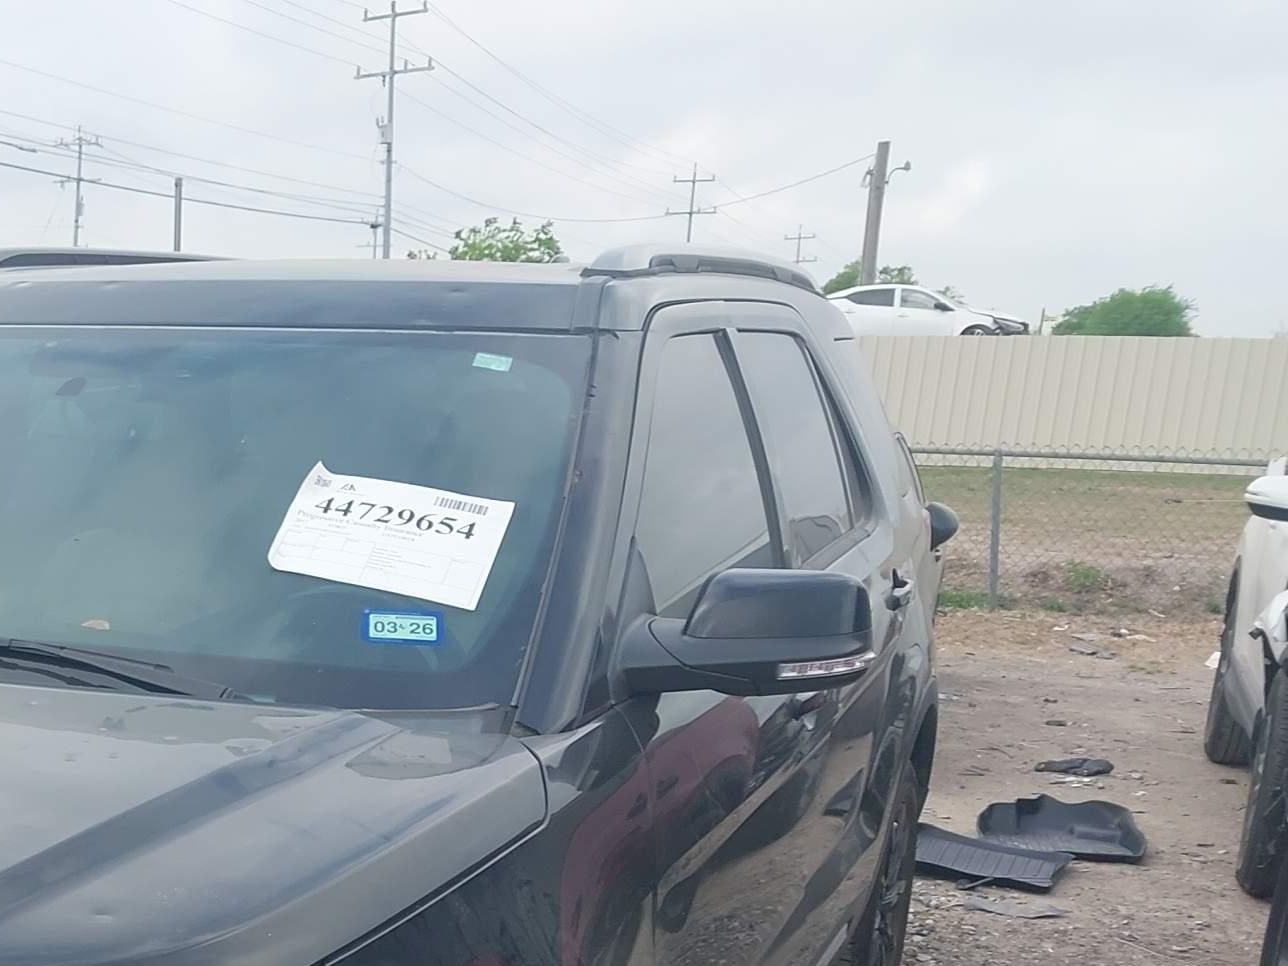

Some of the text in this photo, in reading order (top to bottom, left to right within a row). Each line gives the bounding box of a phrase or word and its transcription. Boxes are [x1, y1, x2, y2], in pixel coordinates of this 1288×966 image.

[314, 496, 477, 540] 44729654
[374, 621, 434, 635] 03 26
